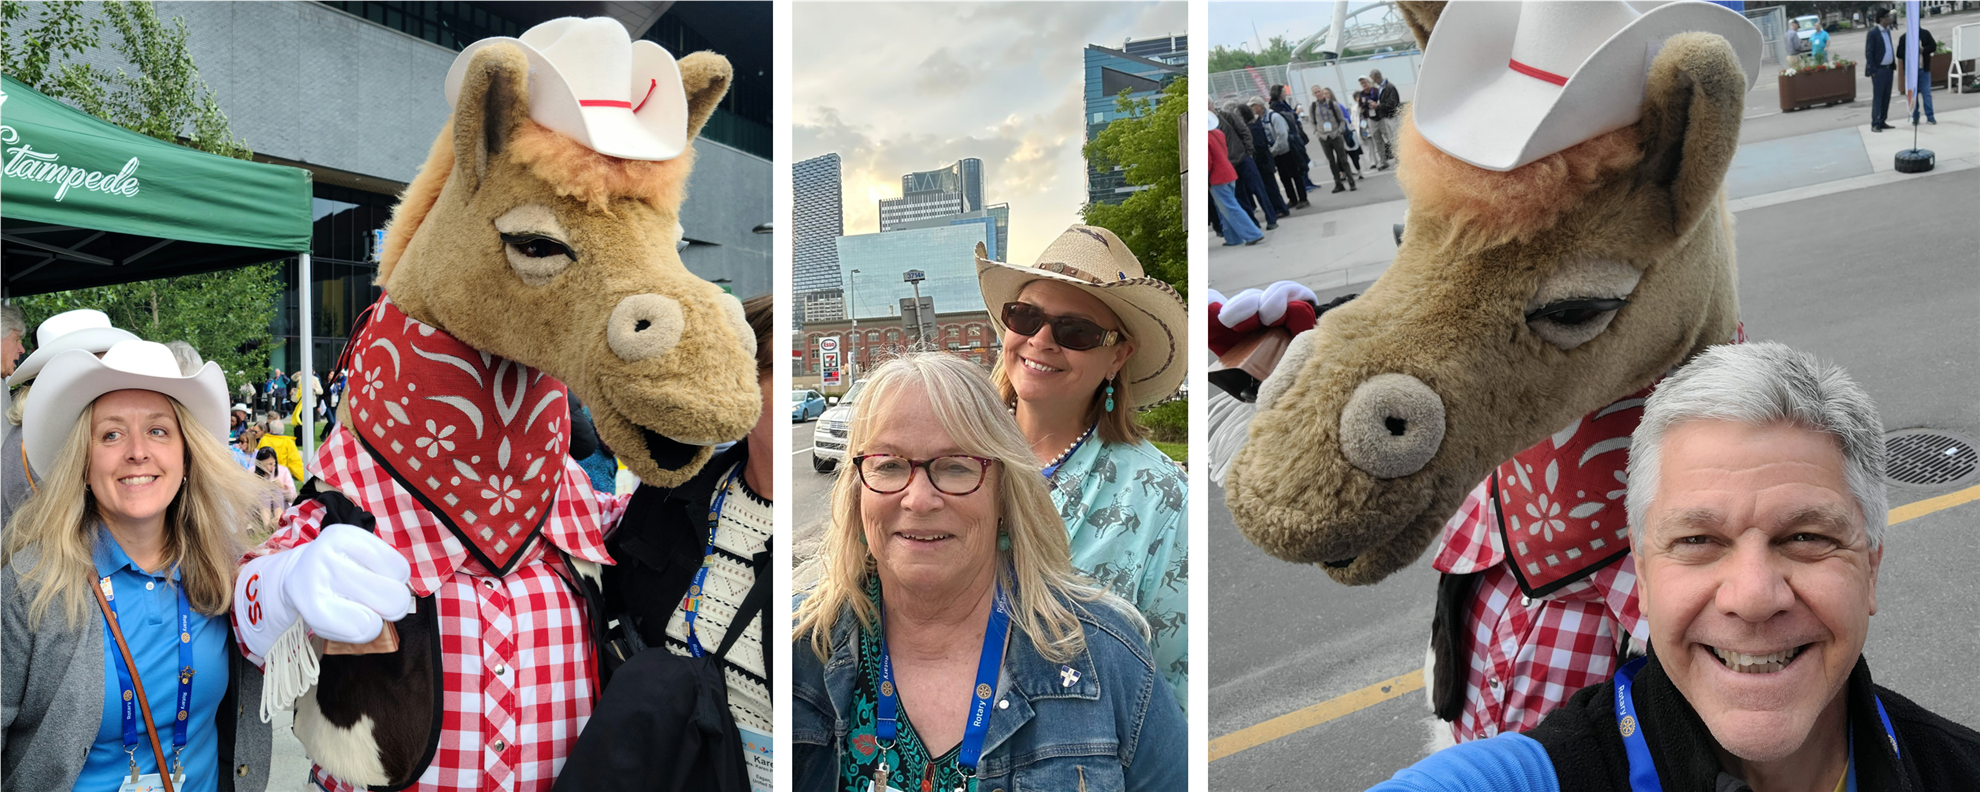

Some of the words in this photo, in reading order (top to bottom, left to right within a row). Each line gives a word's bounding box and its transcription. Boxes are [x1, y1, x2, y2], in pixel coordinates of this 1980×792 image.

[245, 573, 263, 626] CS
[973, 700, 987, 727] Rotary
[1618, 684, 1627, 716] Rotary
[753, 754, 773, 768] Kare
